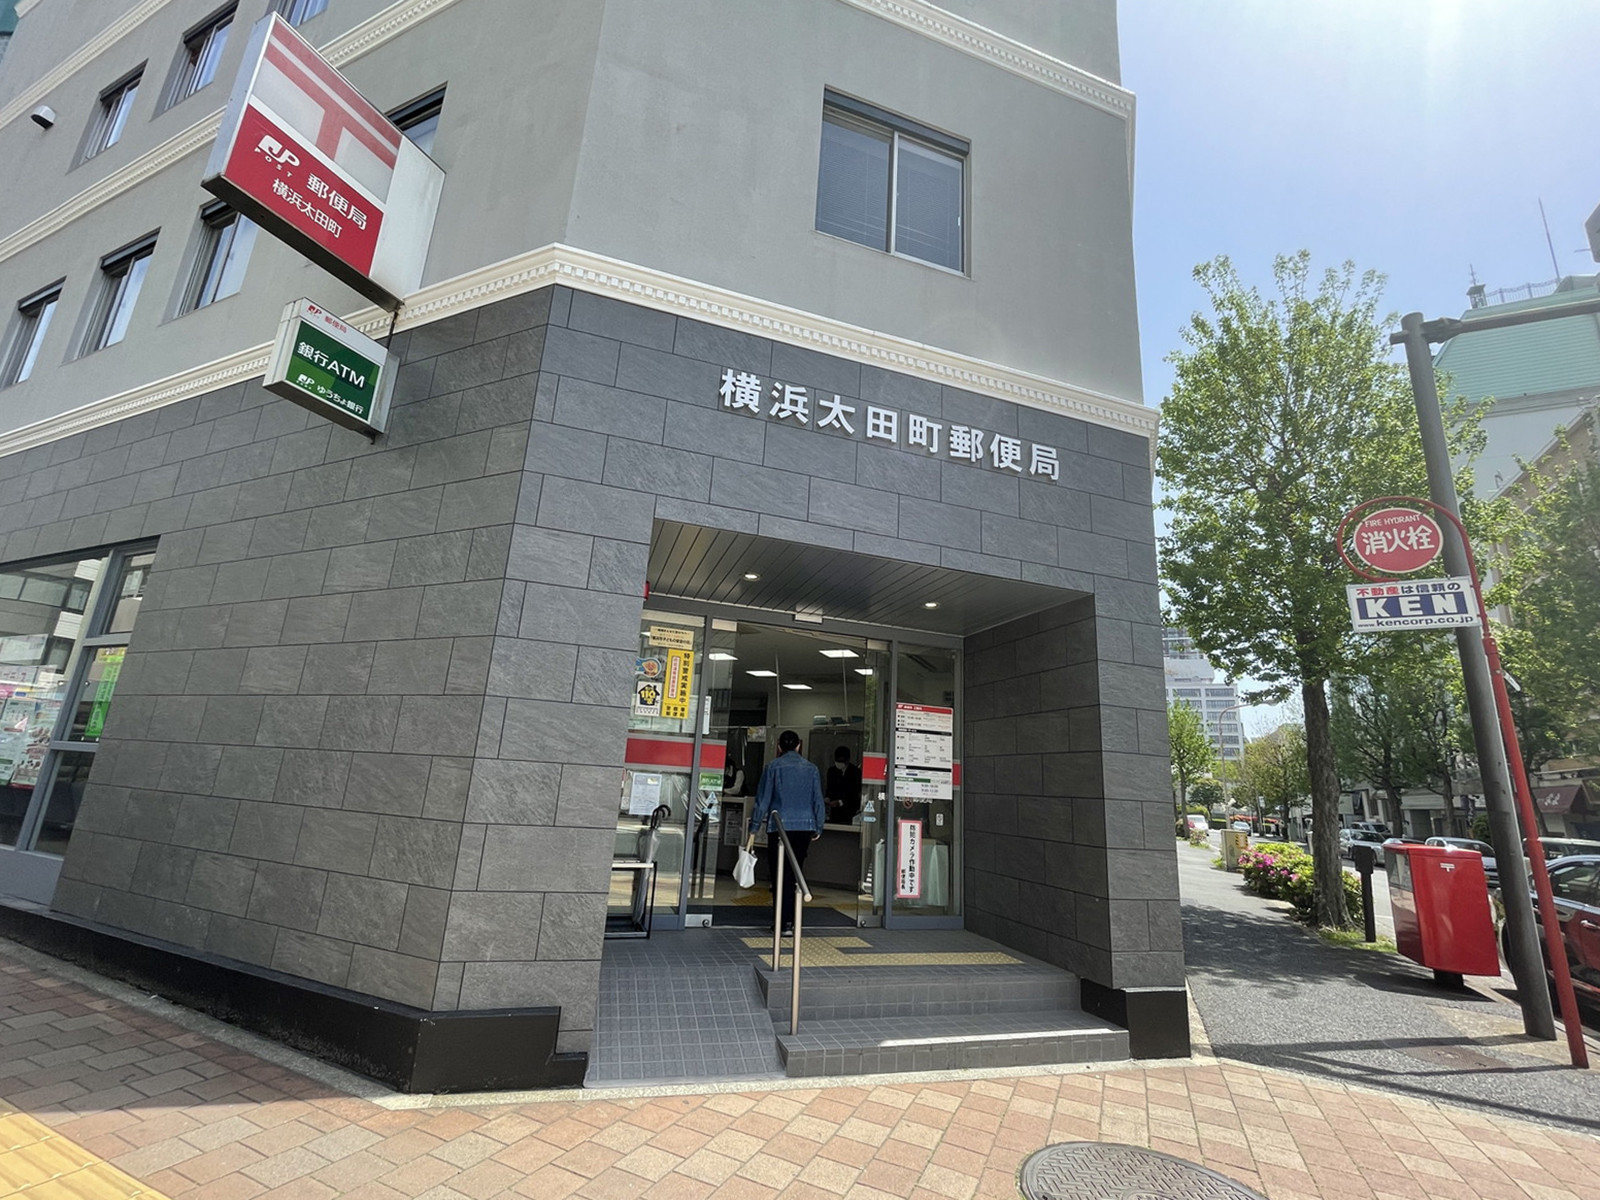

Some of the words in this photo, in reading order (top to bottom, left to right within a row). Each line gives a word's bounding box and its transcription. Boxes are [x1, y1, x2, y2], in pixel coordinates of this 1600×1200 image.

[254, 147, 292, 177] POST
[272, 178, 343, 238] 横浜太田町
[306, 173, 367, 230] 郵便局
[298, 341, 365, 388] 銀行ATM
[317, 384, 364, 414] ゆうちょ銀行
[719, 368, 1060, 481] 横浜太田町郵便局
[1365, 518, 1382, 528] FIRE
[1384, 514, 1420, 524] HYDRANT
[1361, 524, 1435, 555] 消火栓
[1356, 582, 1461, 597] 不動産は信頼の
[1364, 593, 1458, 619] KEN
